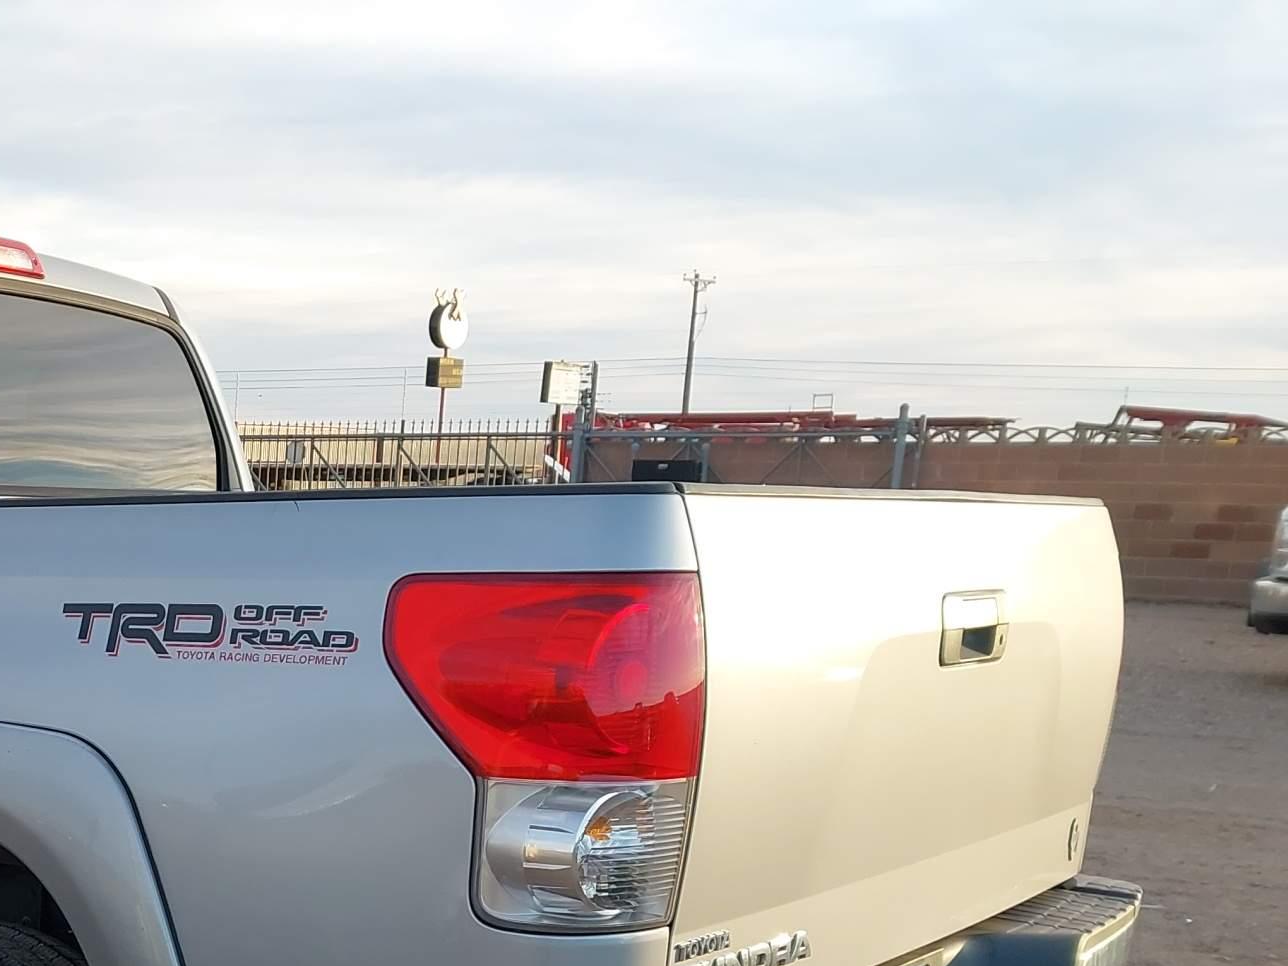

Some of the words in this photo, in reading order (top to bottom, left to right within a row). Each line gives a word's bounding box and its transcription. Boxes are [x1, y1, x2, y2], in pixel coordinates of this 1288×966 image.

[63, 602, 227, 658] TRD
[233, 604, 327, 625] OFF
[229, 628, 359, 652] ROAD
[176, 650, 215, 661] TOYOTA
[219, 651, 260, 663] RACING
[263, 653, 349, 666] DEVELOPMENT
[673, 929, 730, 963] TOYOTA
